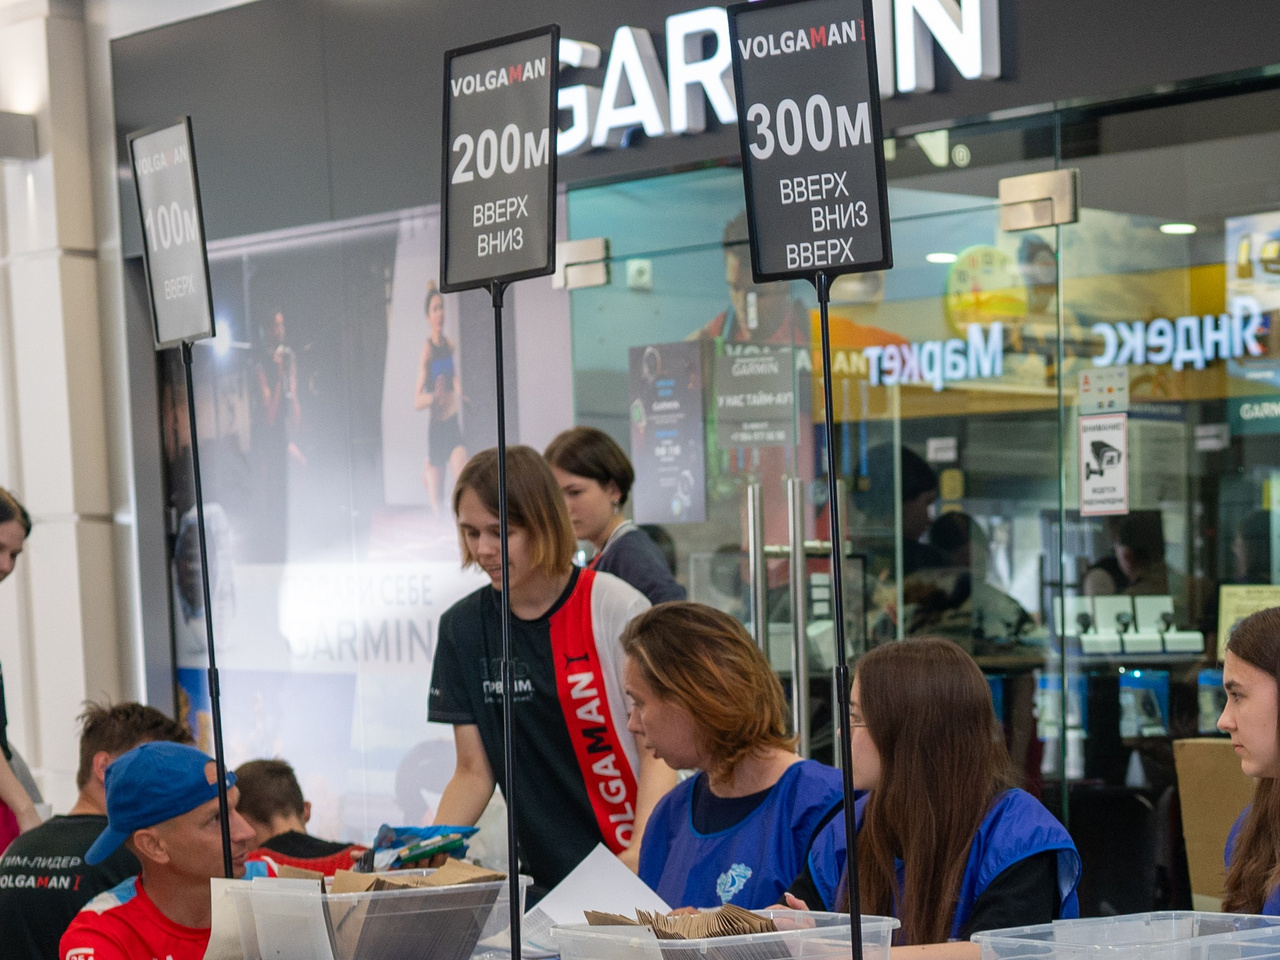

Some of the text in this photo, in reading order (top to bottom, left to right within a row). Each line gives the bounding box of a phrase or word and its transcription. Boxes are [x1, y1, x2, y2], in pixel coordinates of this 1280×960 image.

[738, 19, 857, 60] VOLGAMAN
[451, 56, 547, 97] VOLGAMAN
[556, 0, 985, 156] GARN
[779, 171, 849, 205] ВВЕРХ
[473, 194, 528, 228] ВВЕРХ
[811, 200, 868, 232] ВНИЗ
[477, 227, 523, 257] ВНИЗ
[786, 237, 854, 269] ВВЕРХ
[164, 273, 195, 300] ВВЕРХ
[380, 574, 433, 606] СЕБЕ
[567, 671, 636, 849] OLGAMAN
[0, 874, 71, 889] OLGAMAN
